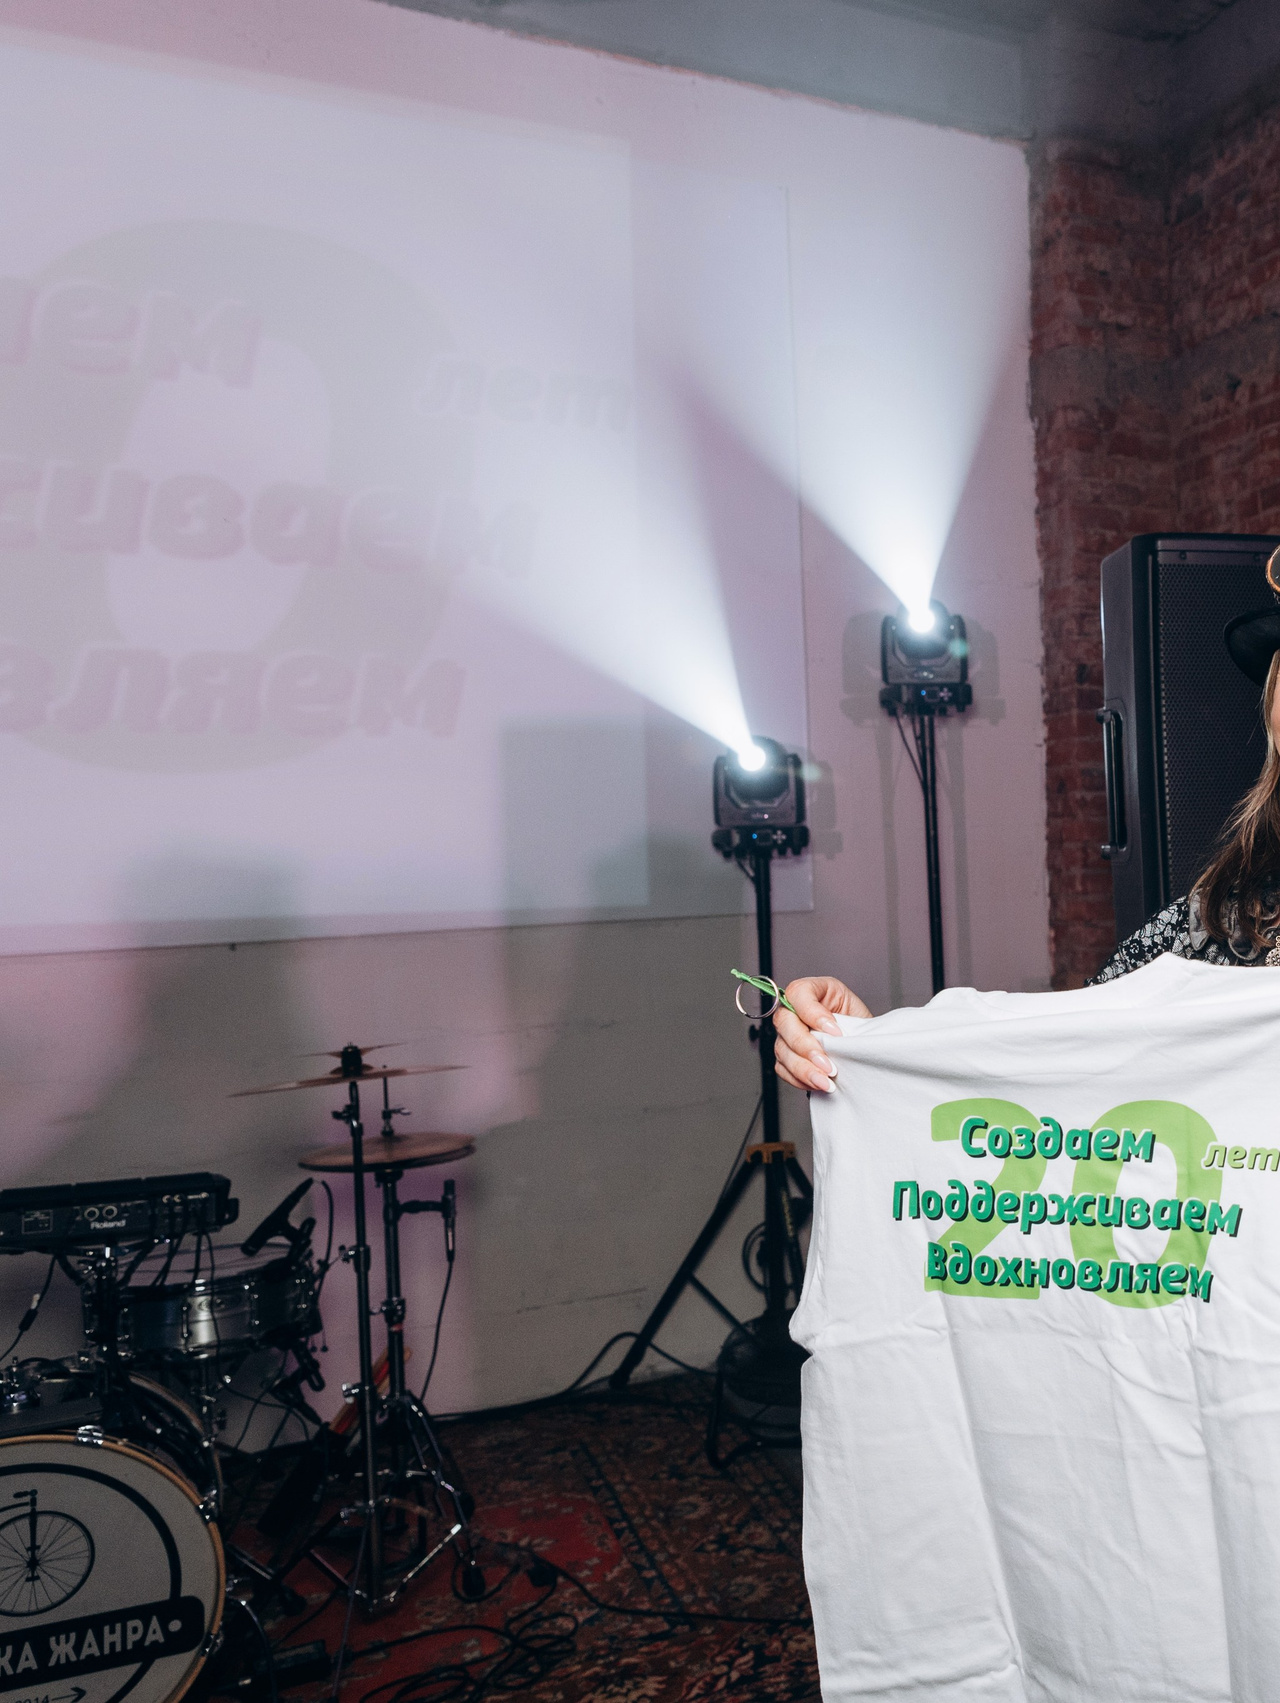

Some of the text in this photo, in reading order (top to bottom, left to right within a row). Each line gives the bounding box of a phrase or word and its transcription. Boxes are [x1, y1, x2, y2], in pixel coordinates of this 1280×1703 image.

[960, 1116, 1156, 1162] Создаем
[1202, 1142, 1280, 1172] лет
[90, 1219, 126, 1230] Roland
[892, 1179, 1244, 1238] Поддерживаем
[48, 1615, 164, 1667] ЖАНРА
